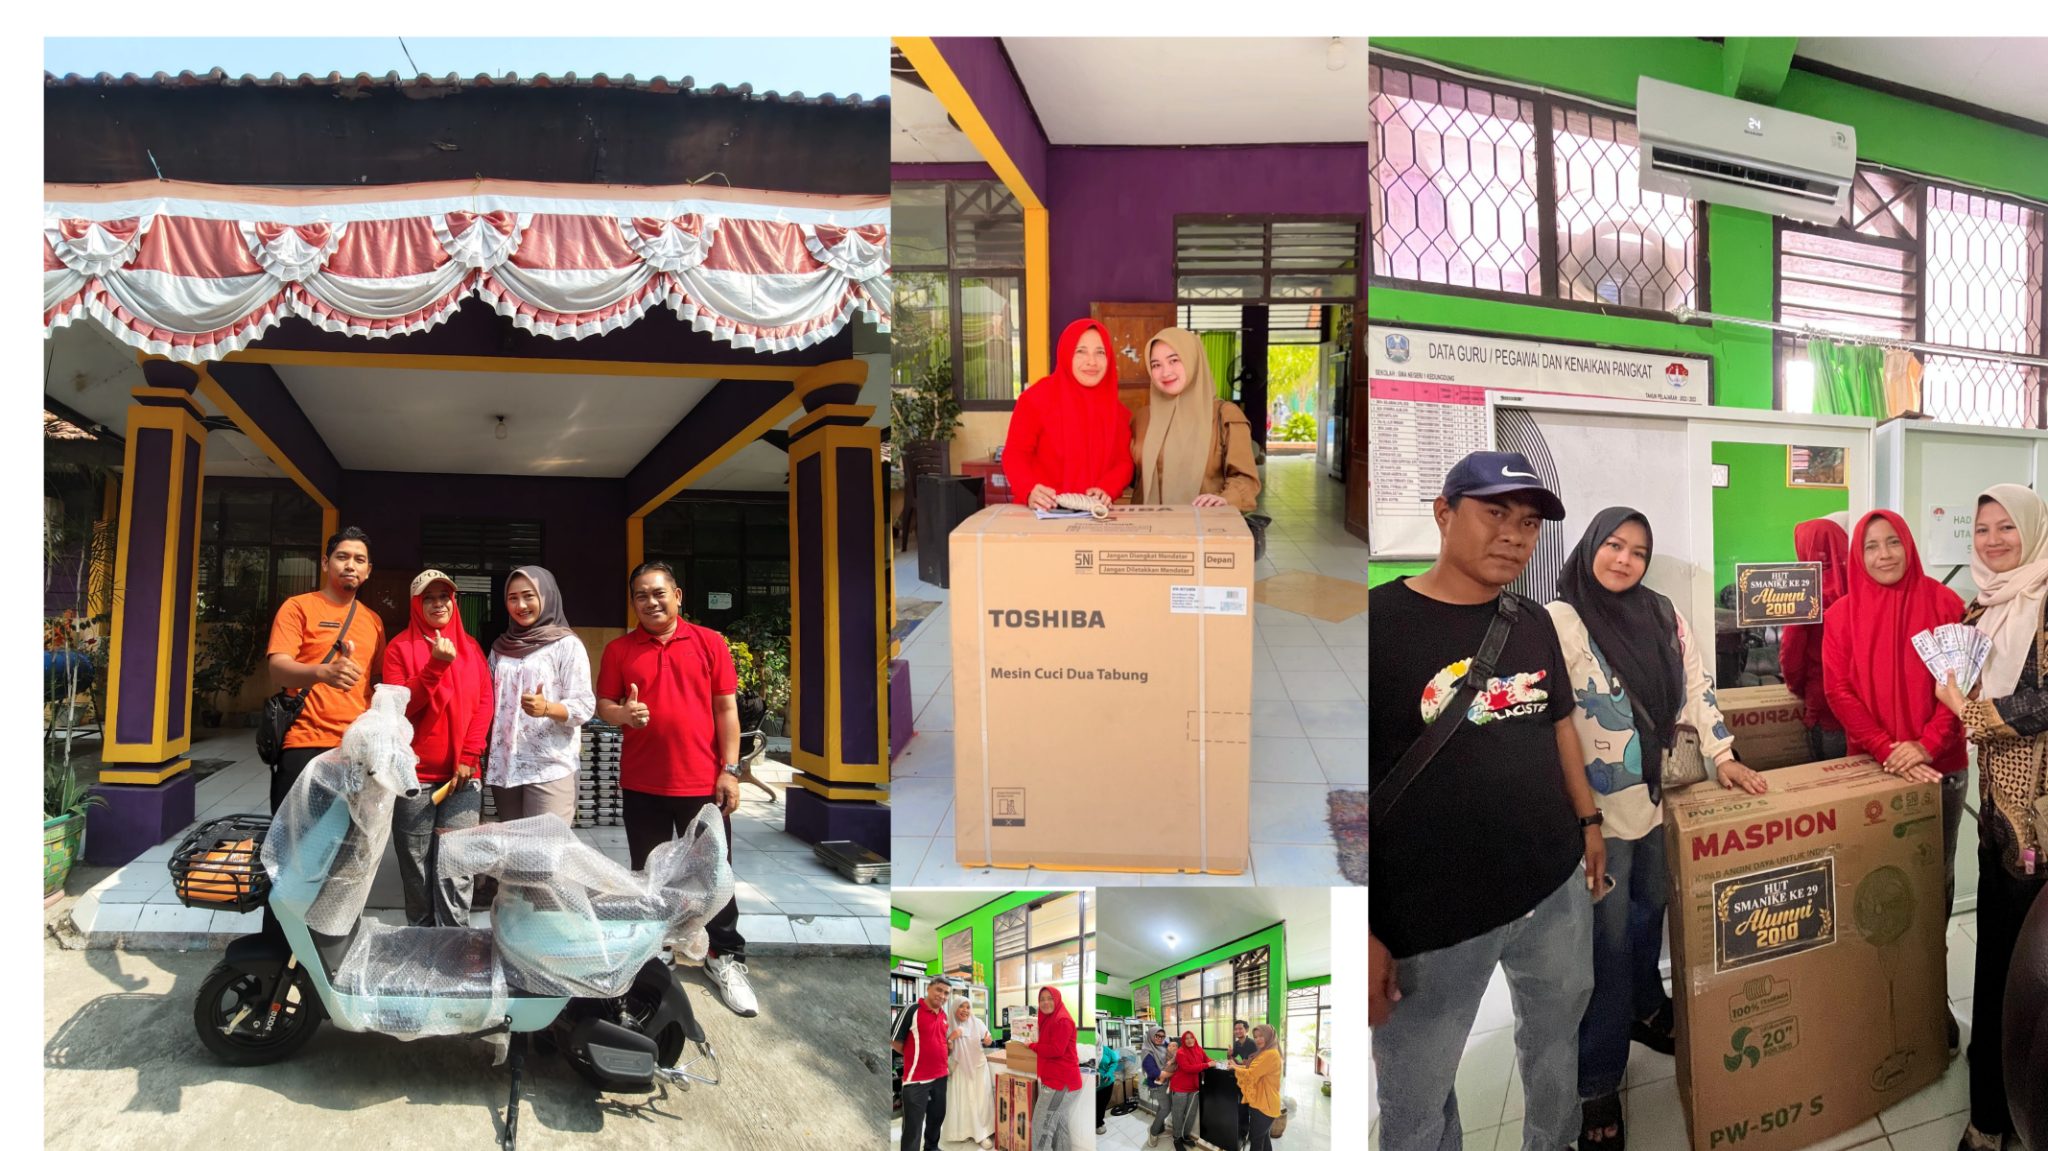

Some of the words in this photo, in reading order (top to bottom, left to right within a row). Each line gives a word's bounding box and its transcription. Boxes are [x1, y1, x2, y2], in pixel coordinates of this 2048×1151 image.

[1748, 117, 1761, 130] 24
[1428, 342, 1456, 361] DATA
[1457, 345, 1487, 364] GURU
[1495, 348, 1540, 368] PEGAWAI
[1542, 354, 1562, 370] DAN
[1564, 356, 1611, 375] KENAIKAN
[1613, 361, 1653, 379] PANGKAT
[1075, 553, 1093, 566] SNI
[1106, 552, 1127, 560] Jangan
[1206, 555, 1232, 564] Depan
[1103, 566, 1125, 574] Jangan
[1771, 572, 1789, 580] HUT
[1750, 580, 1788, 589] SMANIKE
[1789, 579, 1800, 587] KE
[1801, 579, 1810, 587] 29
[1751, 588, 1806, 605] Alumni
[1765, 602, 1796, 616] 2010
[988, 609, 1106, 629] TOSHIBA
[990, 667, 1031, 680] Mesin
[1034, 667, 1063, 680] Cuci
[1067, 668, 1094, 680] Dua
[1097, 668, 1149, 684] Tabung
[1688, 802, 1752, 818] PW-507
[1692, 808, 1837, 861] MASPION
[1722, 863, 1751, 878] ANGIN
[1753, 858, 1775, 871] DAYA
[1777, 852, 1805, 867] UNTUK
[1764, 880, 1789, 895] HUT
[1734, 892, 1787, 914] SMANIKE
[1789, 888, 1805, 901] KE
[1806, 884, 1819, 897] 29
[1735, 898, 1814, 936] Alumni
[1757, 921, 1799, 948] 2010
[1732, 1003, 1760, 1018] 100%
[1710, 1102, 1802, 1150] PW-507
[1810, 1095, 1824, 1116] S
